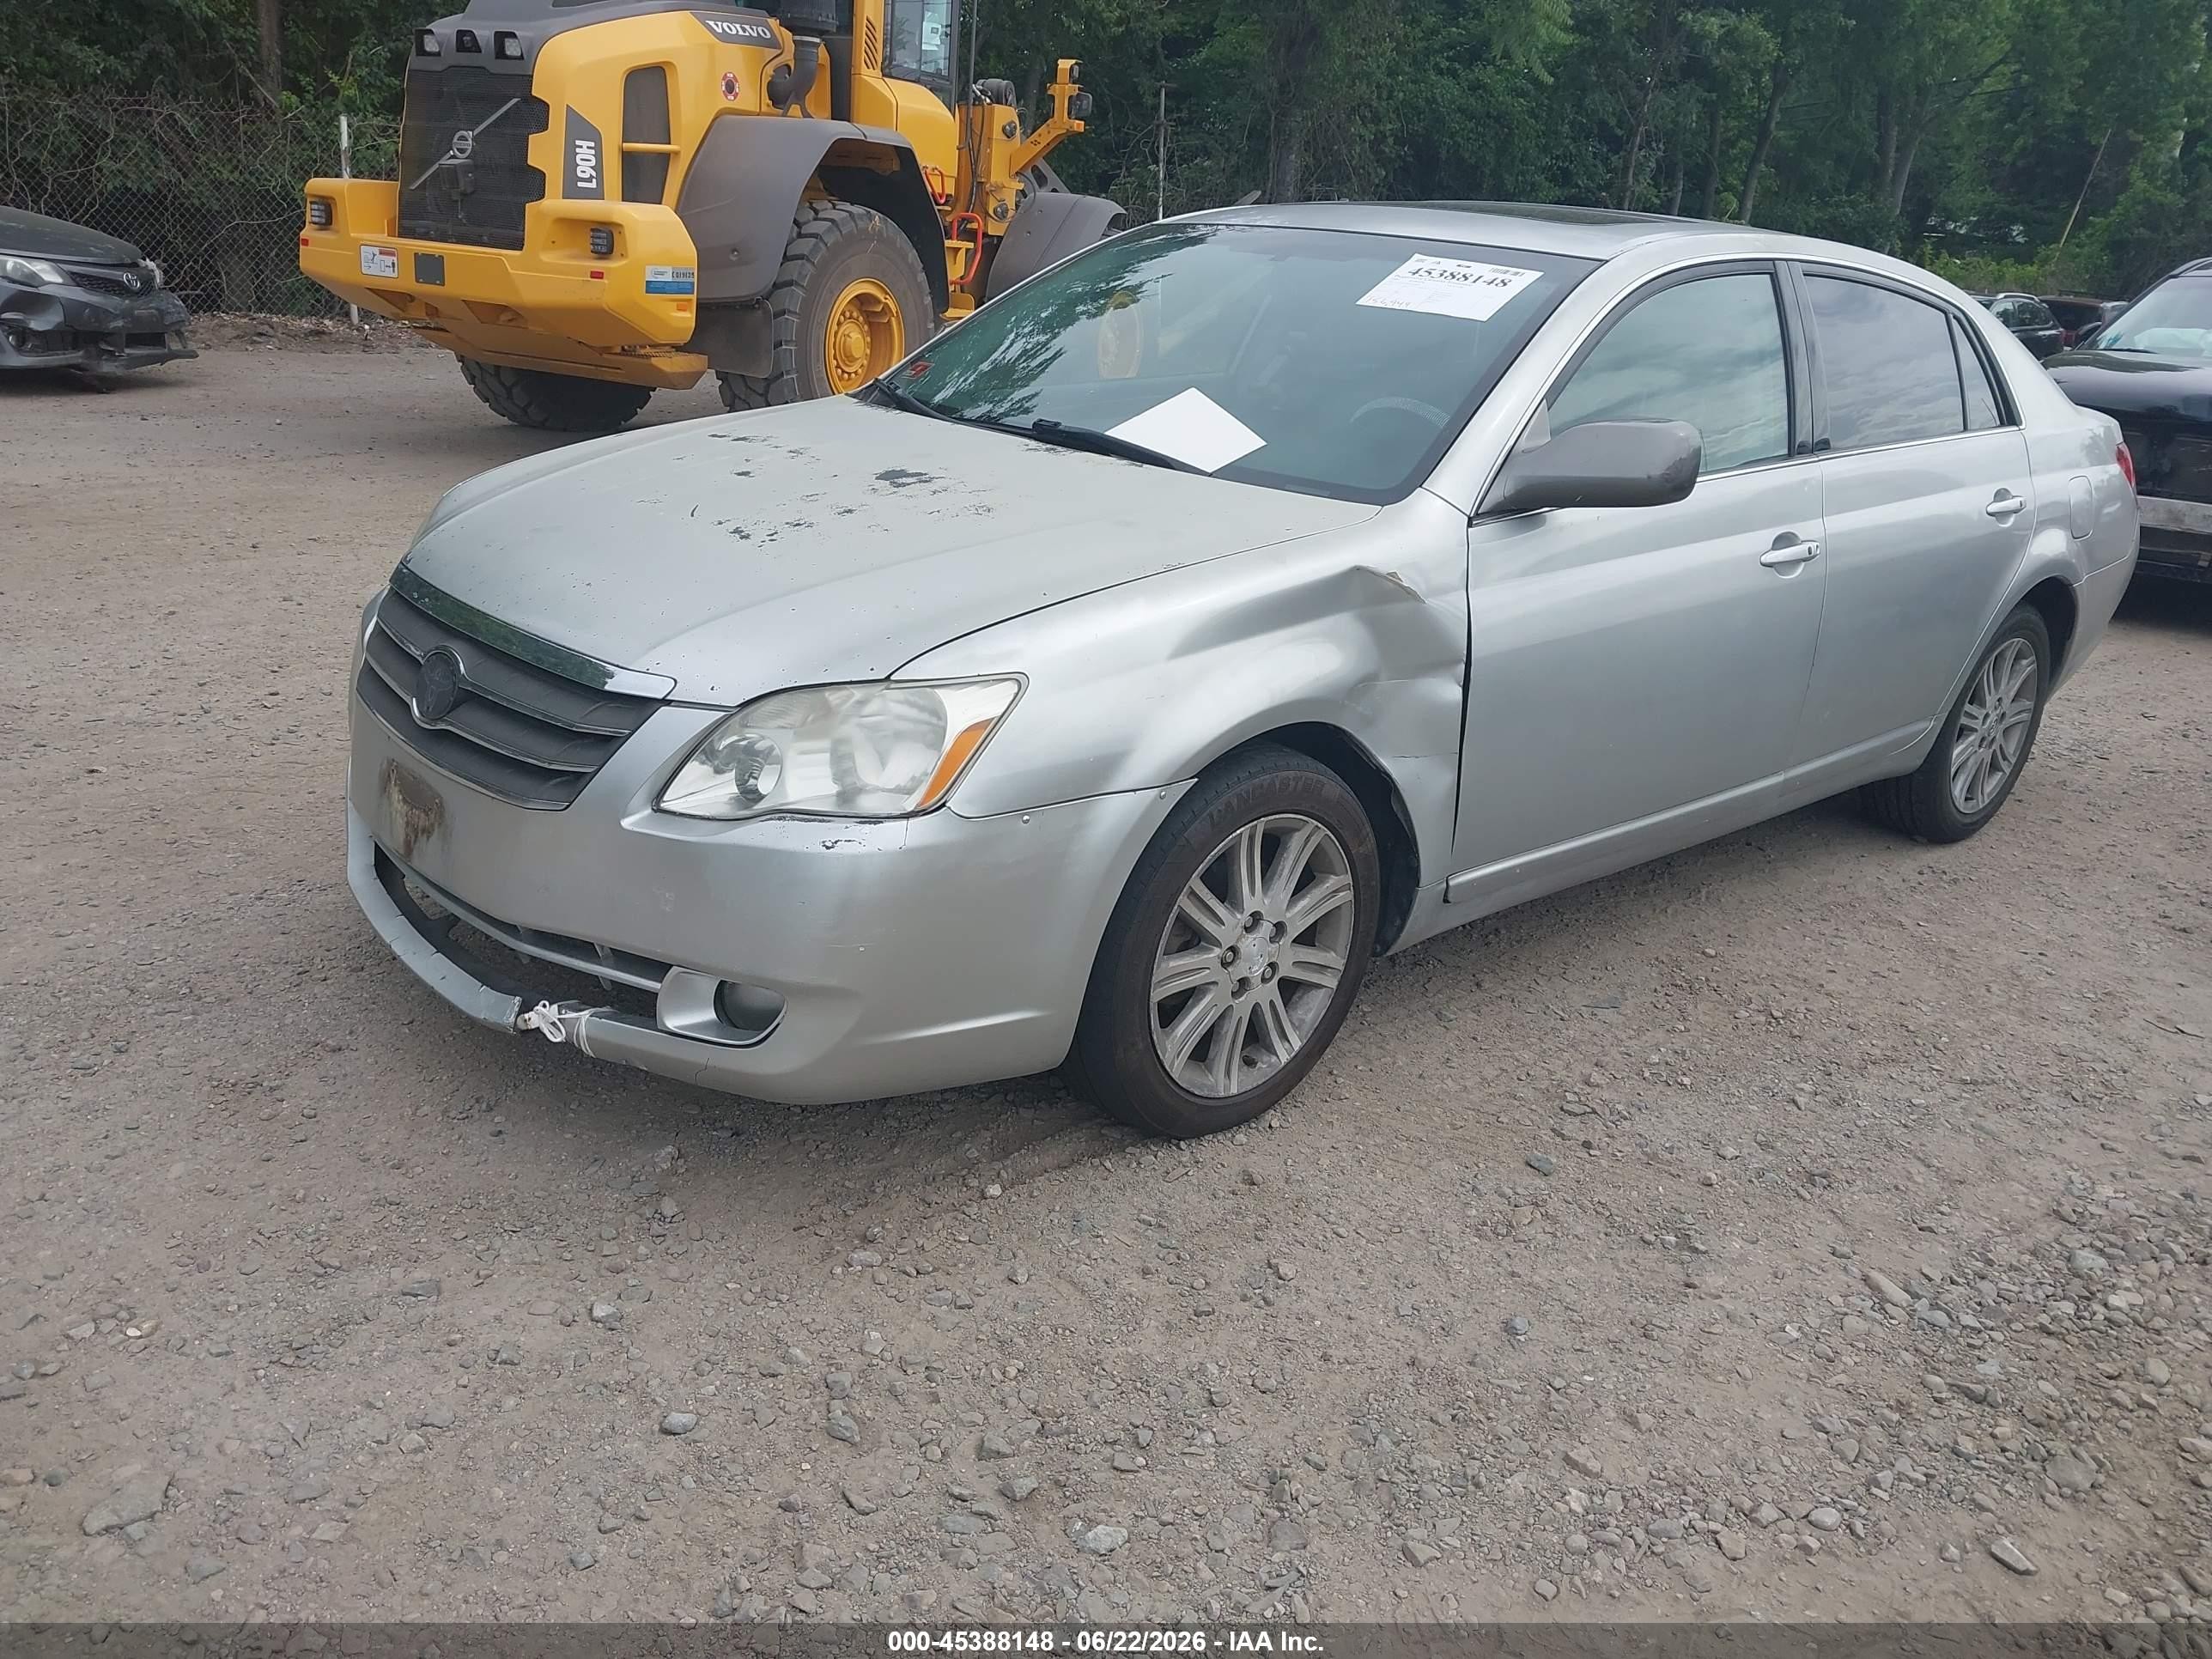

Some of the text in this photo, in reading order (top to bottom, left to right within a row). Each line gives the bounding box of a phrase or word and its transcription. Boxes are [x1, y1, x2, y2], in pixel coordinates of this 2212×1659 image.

[705, 20, 771, 39] VOLVO
[574, 139, 598, 189] L90H
[1408, 267, 1513, 288] 45388148
